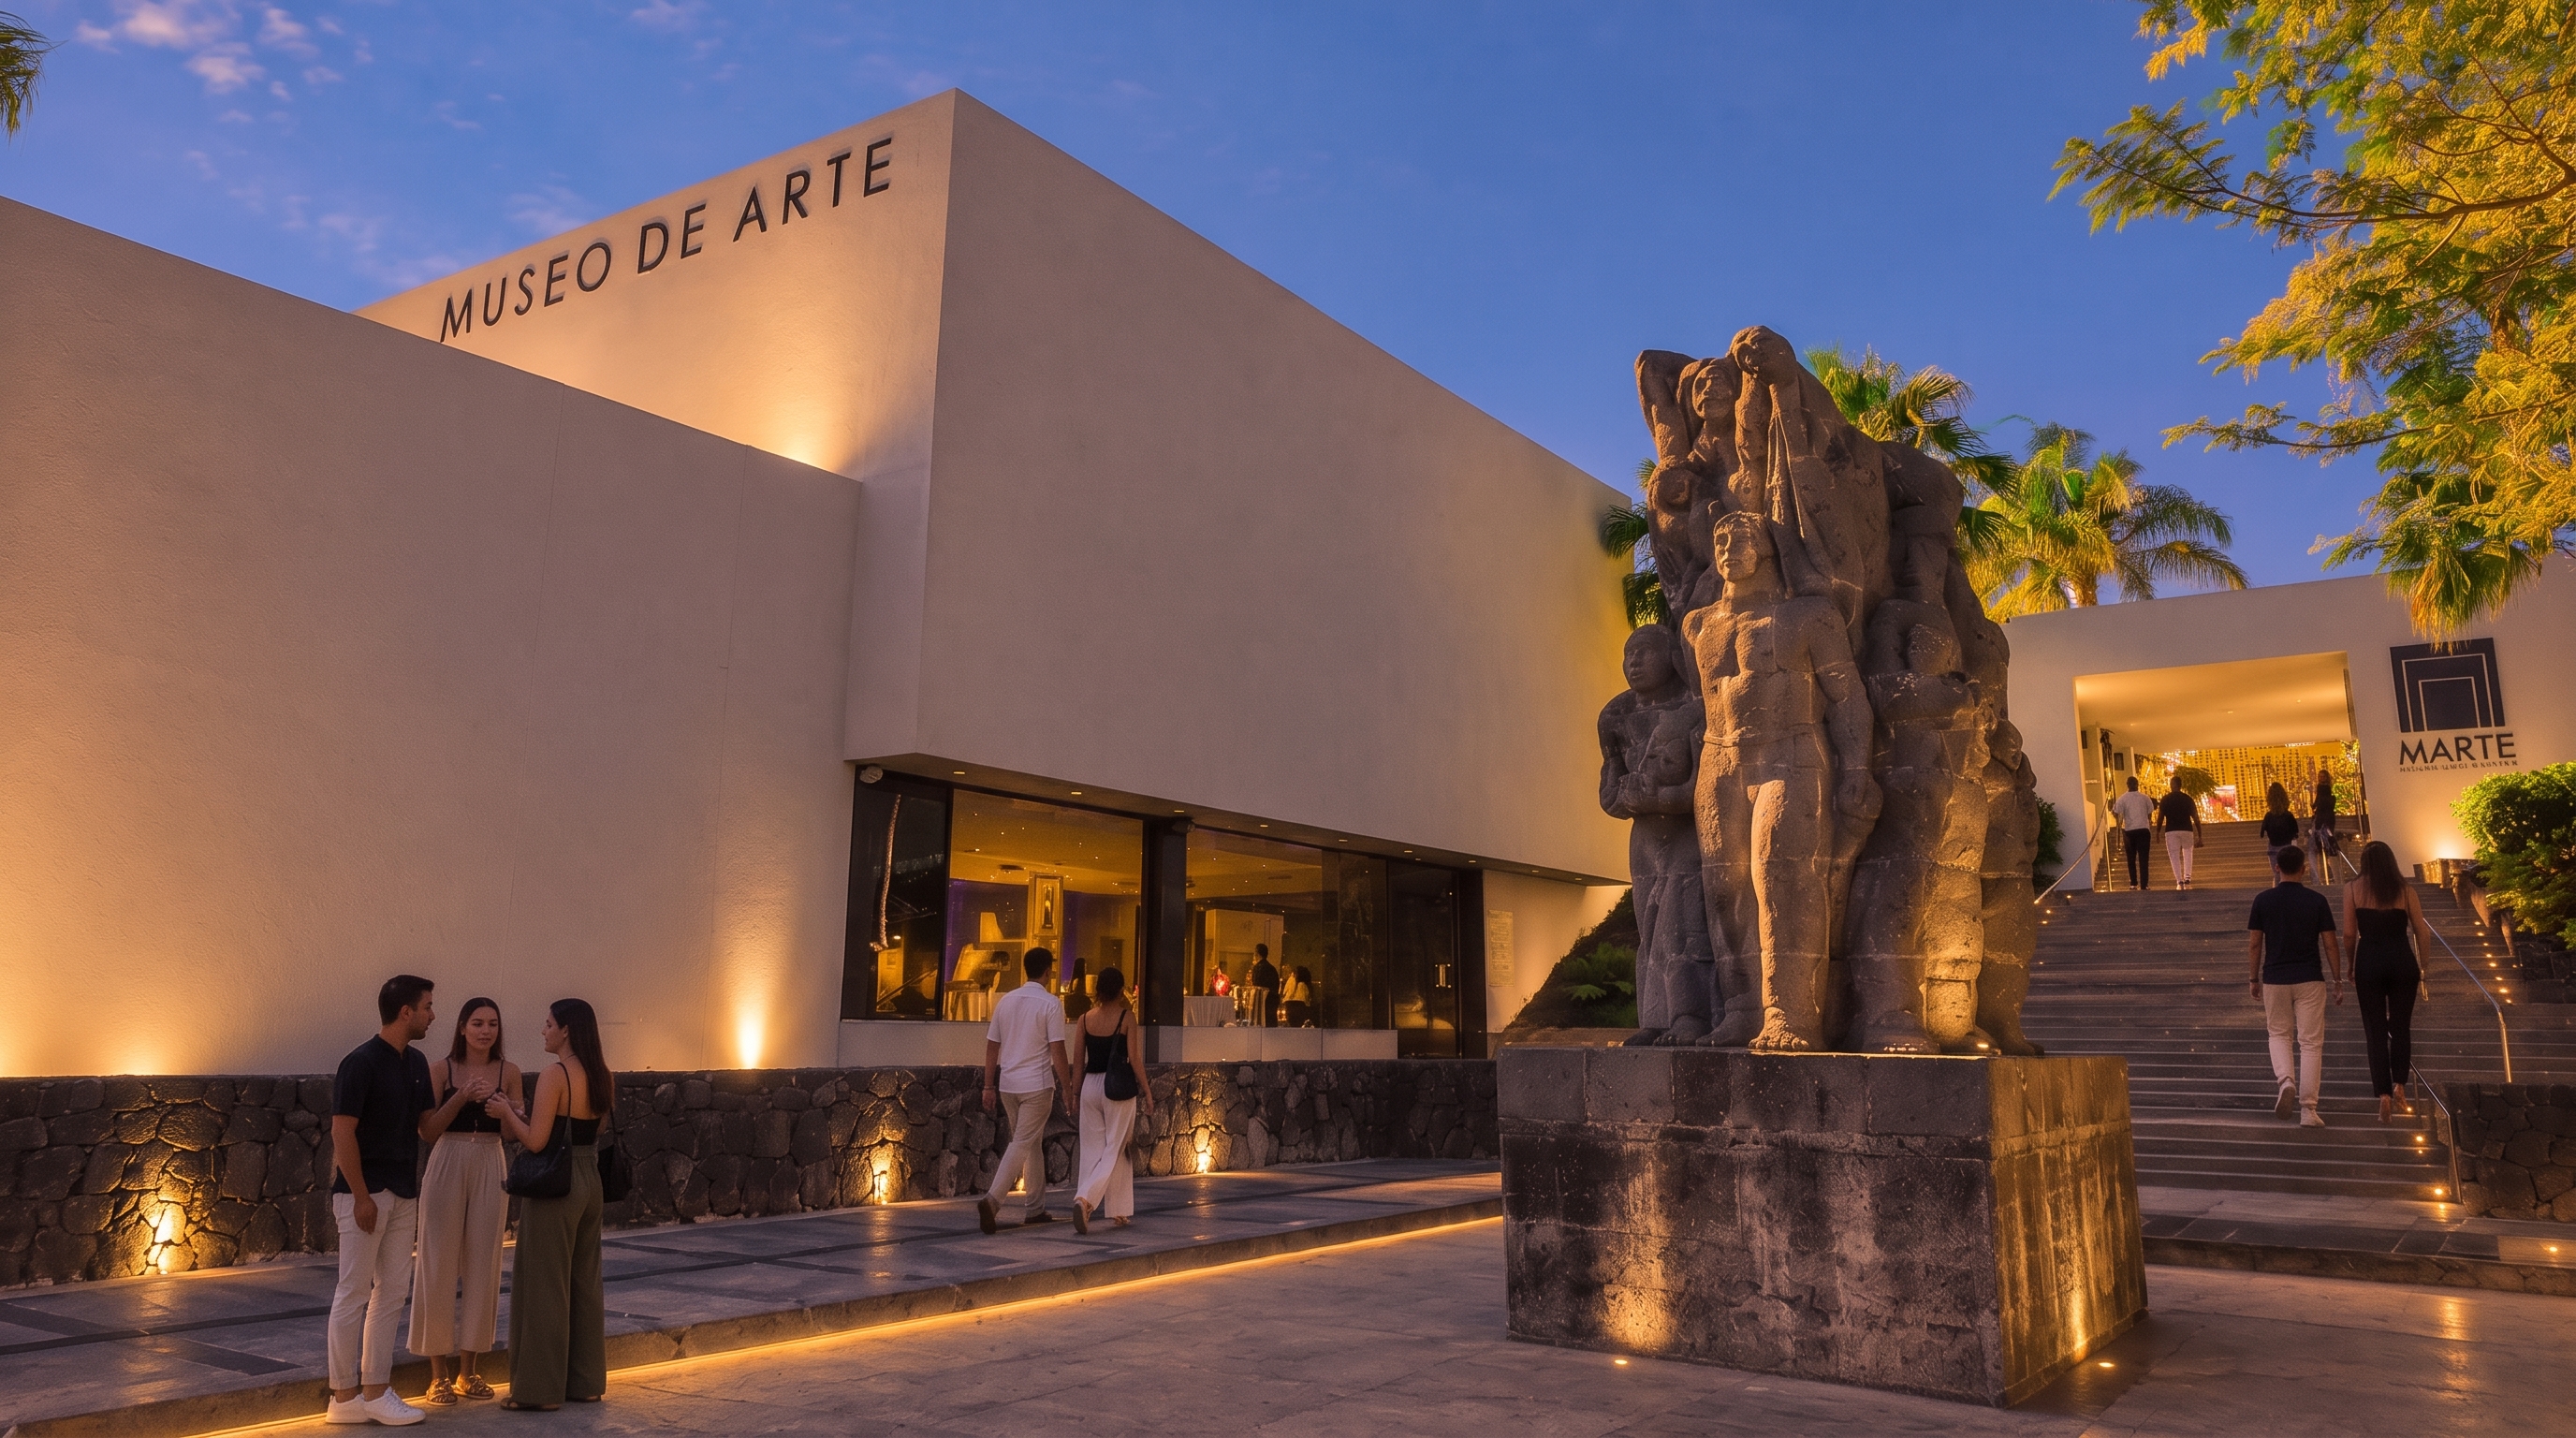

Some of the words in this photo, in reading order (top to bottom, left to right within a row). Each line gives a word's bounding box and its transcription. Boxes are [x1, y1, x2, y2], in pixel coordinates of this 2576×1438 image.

[440, 242, 612, 344] MUSEO
[637, 202, 707, 274] DE
[733, 137, 893, 242] ARTE
[2399, 732, 2517, 766] MARTE
